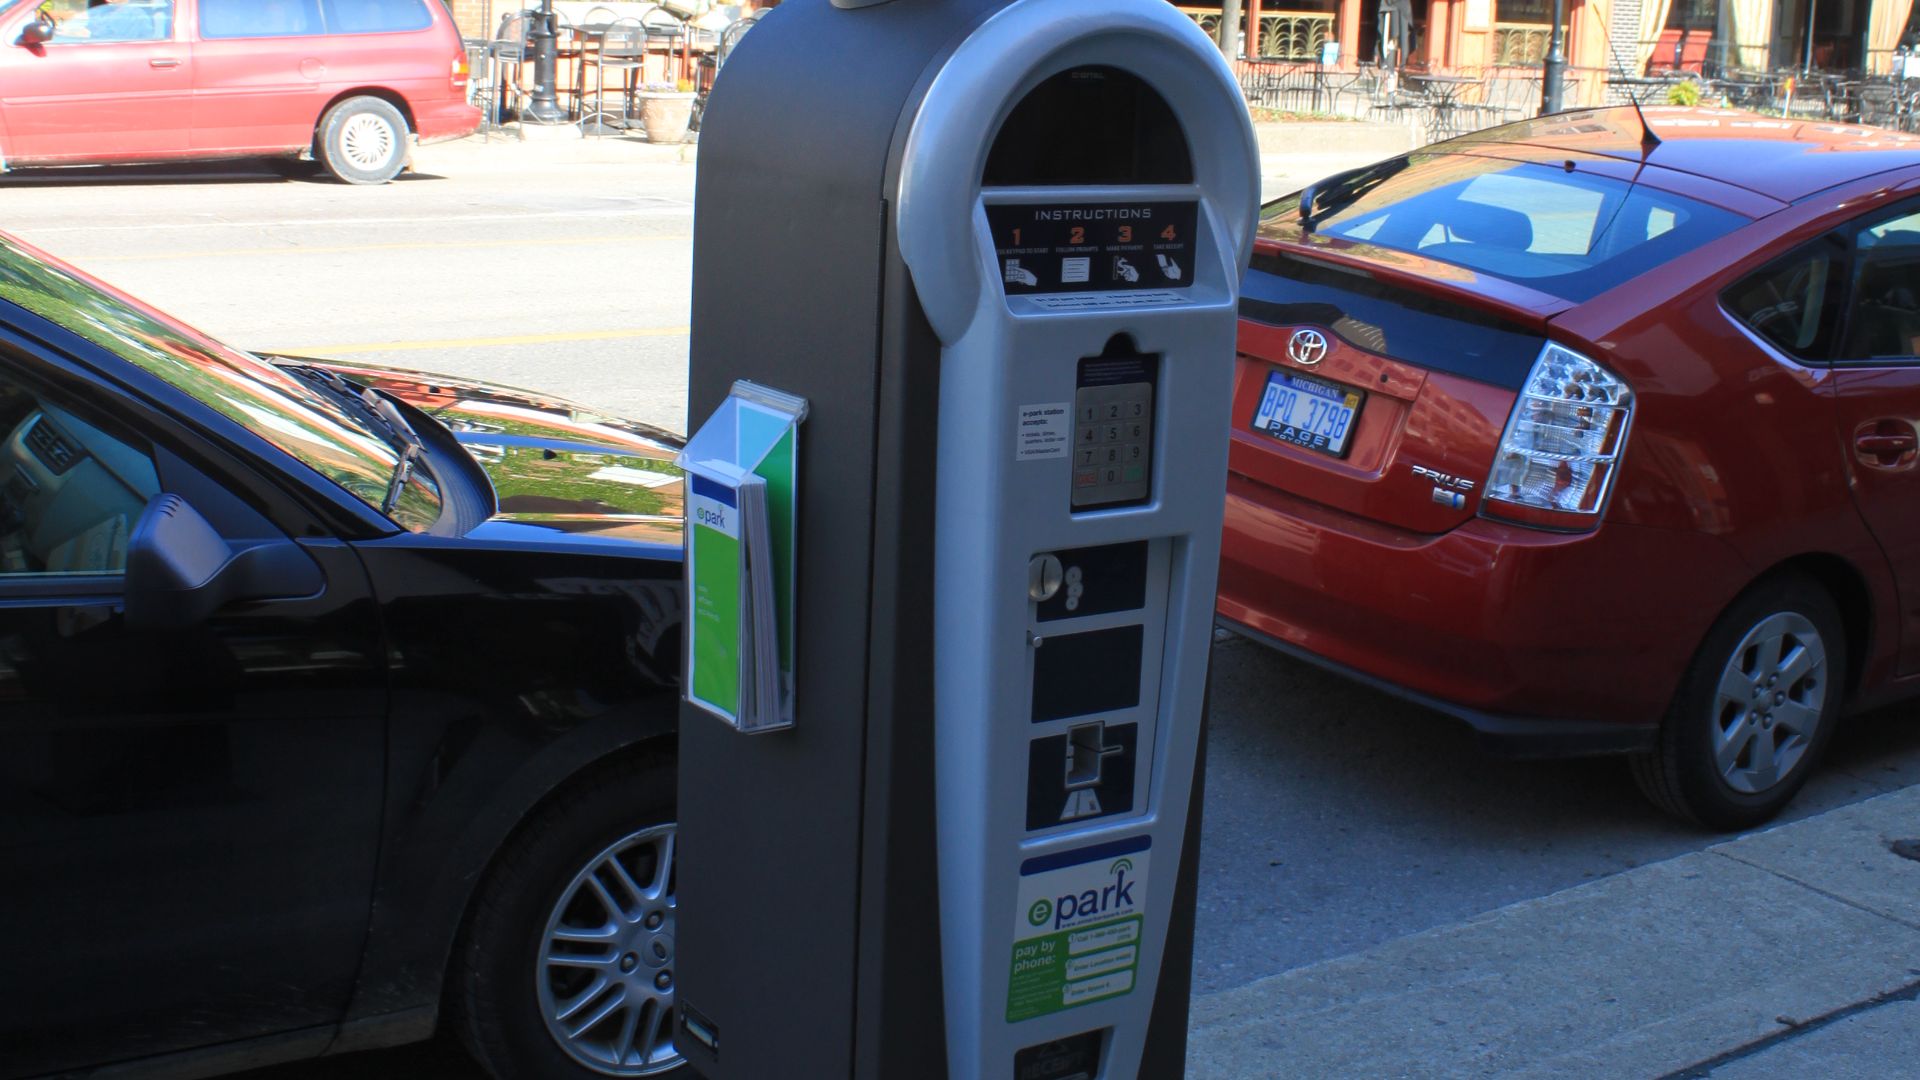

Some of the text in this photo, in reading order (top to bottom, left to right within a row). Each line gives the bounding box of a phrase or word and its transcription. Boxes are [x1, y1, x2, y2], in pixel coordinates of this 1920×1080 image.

[1034, 208, 1152, 221] INSTRUCTIONS
[1012, 224, 1177, 246] 1 2 3 4
[1291, 377, 1339, 399] MICHIGAN
[1111, 405, 1118, 418] 2
[1134, 403, 1141, 416] 3
[1302, 399, 1351, 439] 3798
[1086, 425, 1140, 441] 4 5 6
[1269, 422, 1326, 446] PAGE
[1273, 432, 1316, 449] TOYOTA
[1086, 447, 1139, 463] 7 8 9
[1107, 470, 1114, 482] 0
[1412, 465, 1475, 490] PRIUS
[1015, 939, 1057, 960] pay by
[1014, 954, 1057, 975] phone:
